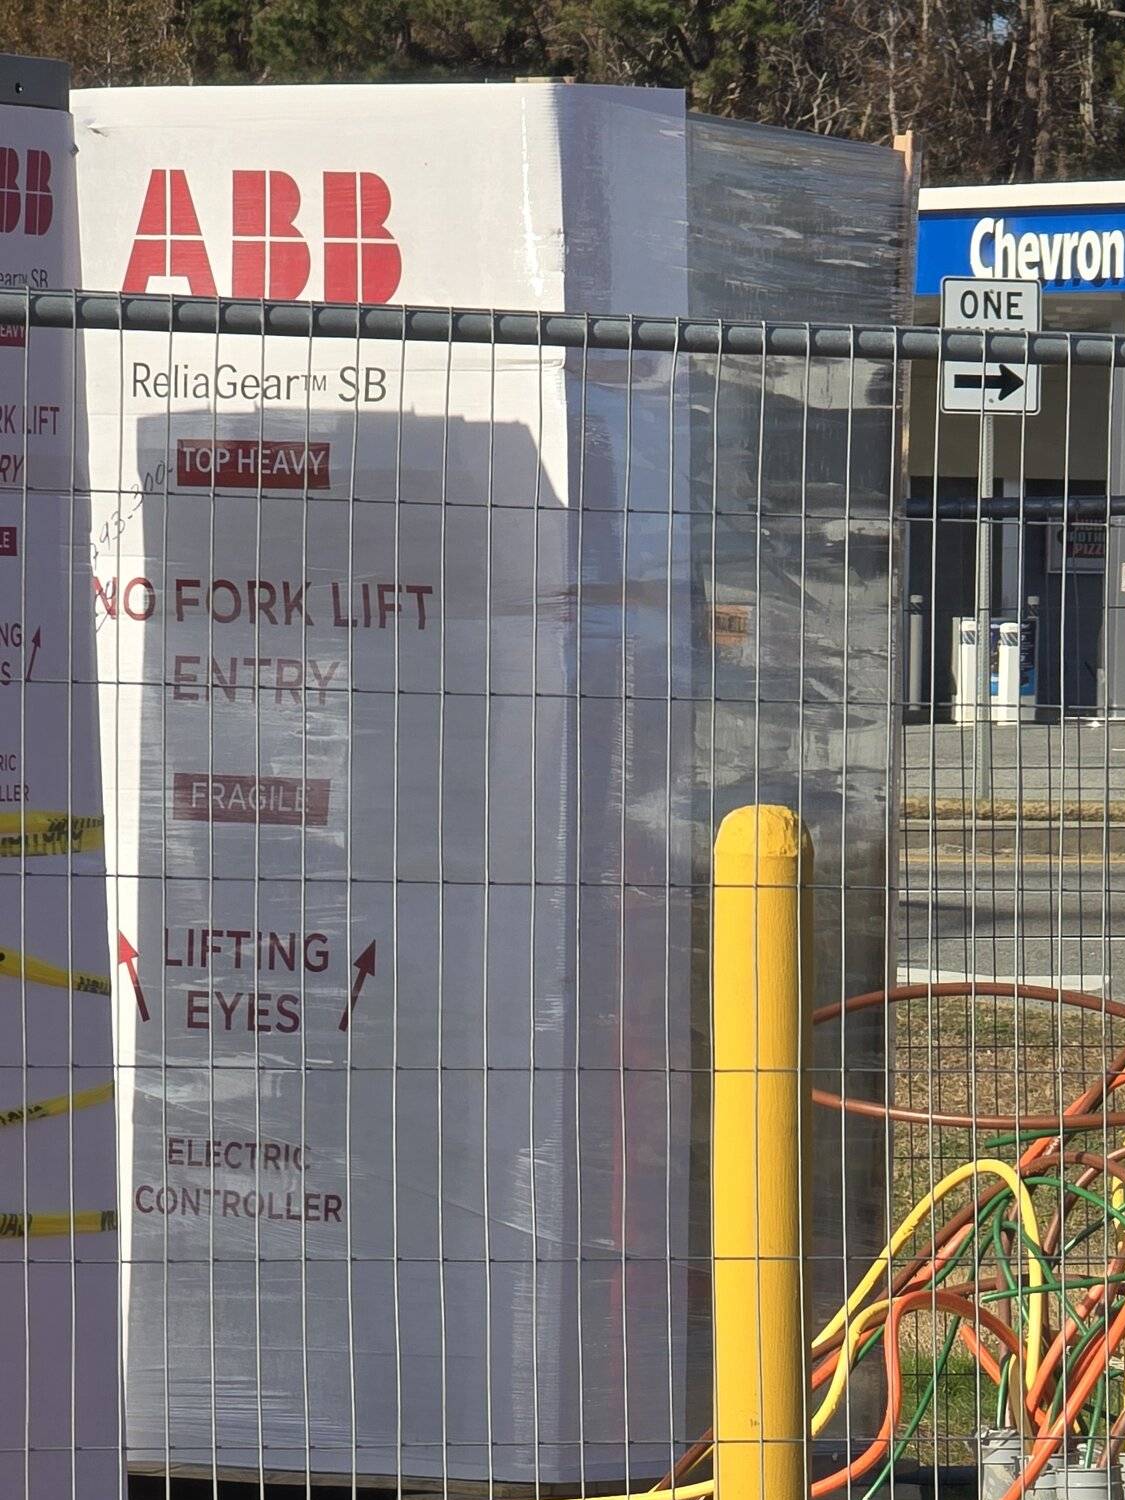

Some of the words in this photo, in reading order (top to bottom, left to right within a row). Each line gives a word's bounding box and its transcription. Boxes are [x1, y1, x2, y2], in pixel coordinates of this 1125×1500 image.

[122, 169, 402, 305] ABB
[970, 216, 1125, 282] Chevron
[960, 290, 1024, 320] ONE
[338, 366, 388, 402] SB
[22, 405, 60, 436] LIFT
[183, 446, 230, 474] TOP
[238, 451, 325, 477] HEAVY
[94, 575, 156, 621] NO
[176, 579, 314, 627] FORK
[332, 582, 433, 631] LIFT
[173, 654, 340, 706] ENTRY
[191, 781, 311, 813] FRAGILE
[165, 928, 330, 974] LIFTING
[187, 991, 301, 1034] EYES
[167, 1136, 313, 1172] ELECTRIC
[135, 1184, 343, 1223] CONTROLLER
